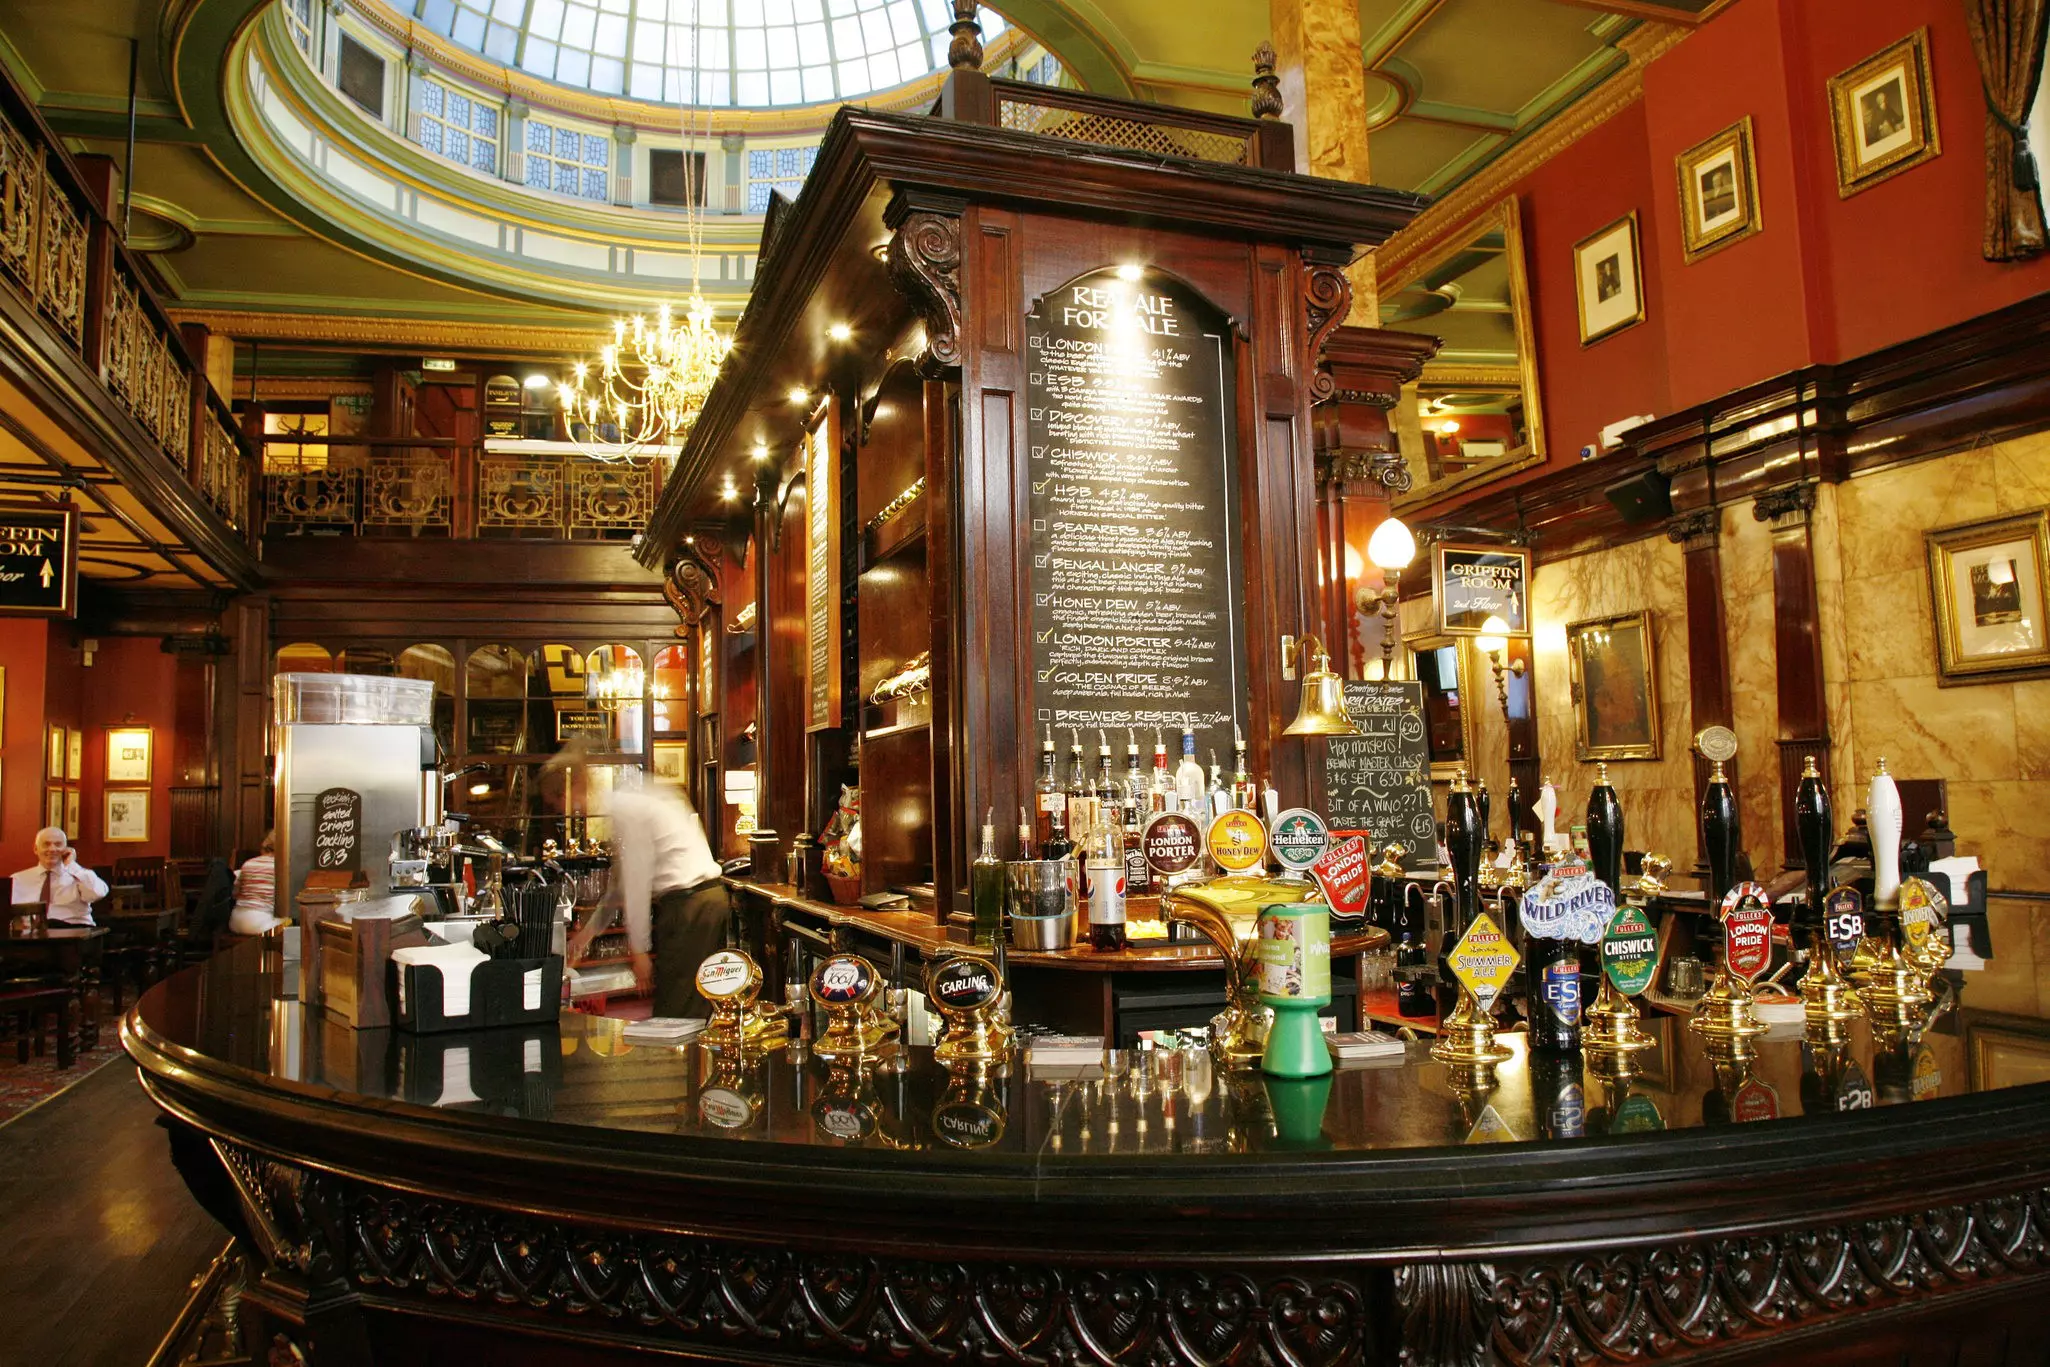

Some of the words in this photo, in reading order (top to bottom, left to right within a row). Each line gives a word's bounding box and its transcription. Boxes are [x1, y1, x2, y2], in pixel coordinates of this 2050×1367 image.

[1072, 286, 1131, 311] RE
[1135, 292, 1173, 317] ALE
[1063, 307, 1109, 330] FOR
[1047, 338, 1103, 354] LONDON
[1047, 374, 1085, 388] ESB
[1049, 409, 1128, 428] DISCOVERY
[1161, 422, 1180, 430] ABV
[1050, 448, 1119, 463] CHISWICK
[1153, 459, 1172, 467] ABV
[1055, 485, 1091, 497] HSB
[1053, 522, 1140, 536] SEAFARERS
[1052, 558, 1109, 571] BENGAL
[1112, 562, 1165, 574] LANCER
[1451, 563, 1520, 579] GRIFFIN
[1461, 576, 1512, 591] ROOM
[1053, 597, 1102, 608] HONEY
[1106, 599, 1138, 610] DEW
[1453, 600, 1470, 609] 2nd
[1470, 596, 1503, 610] Floor
[1054, 635, 1114, 646] LONDON
[1116, 637, 1171, 647] PORTER
[1198, 641, 1216, 649] ABV
[1055, 672, 1113, 683] GOLDEN
[1116, 674, 1158, 684] PRIDE
[1344, 684, 1378, 696] Counting
[1379, 686, 1404, 694] Huse
[1364, 695, 1404, 706] DATES
[1055, 710, 1132, 722] BREWERS
[1134, 711, 1199, 723] RESERVE
[1402, 720, 1420, 735] £20
[1328, 740, 1350, 760] Hop
[1326, 756, 1356, 770] BREWING
[1359, 756, 1393, 770] MASTER
[1350, 772, 1374, 786] SEPT
[1348, 800, 1361, 813] OF
[1362, 800, 1372, 813] A
[319, 820, 354, 832] Crispy
[1361, 816, 1374, 828] THE
[1414, 820, 1432, 833] £15
[1150, 836, 1192, 847] LONDON
[1274, 834, 1324, 846] Heineken
[1149, 845, 1196, 857] PORTER
[1216, 846, 1240, 856] HONEY
[1243, 846, 1259, 856] DEW
[1322, 852, 1364, 882] LONDON
[1333, 864, 1364, 888] PRIDE
[1524, 897, 1566, 922] WILD
[1570, 886, 1612, 914] RIVER
[1730, 924, 1768, 938] LONDON
[1828, 914, 1862, 940] ESB
[1604, 938, 1654, 956] CHISWICK
[1736, 936, 1762, 946] PRIDE
[1458, 955, 1512, 972] SUMMER
[700, 968, 716, 982] San
[715, 966, 742, 978] Miguel
[828, 972, 854, 986] 1664
[1474, 967, 1496, 977] ALE
[942, 975, 988, 994] CARLING
